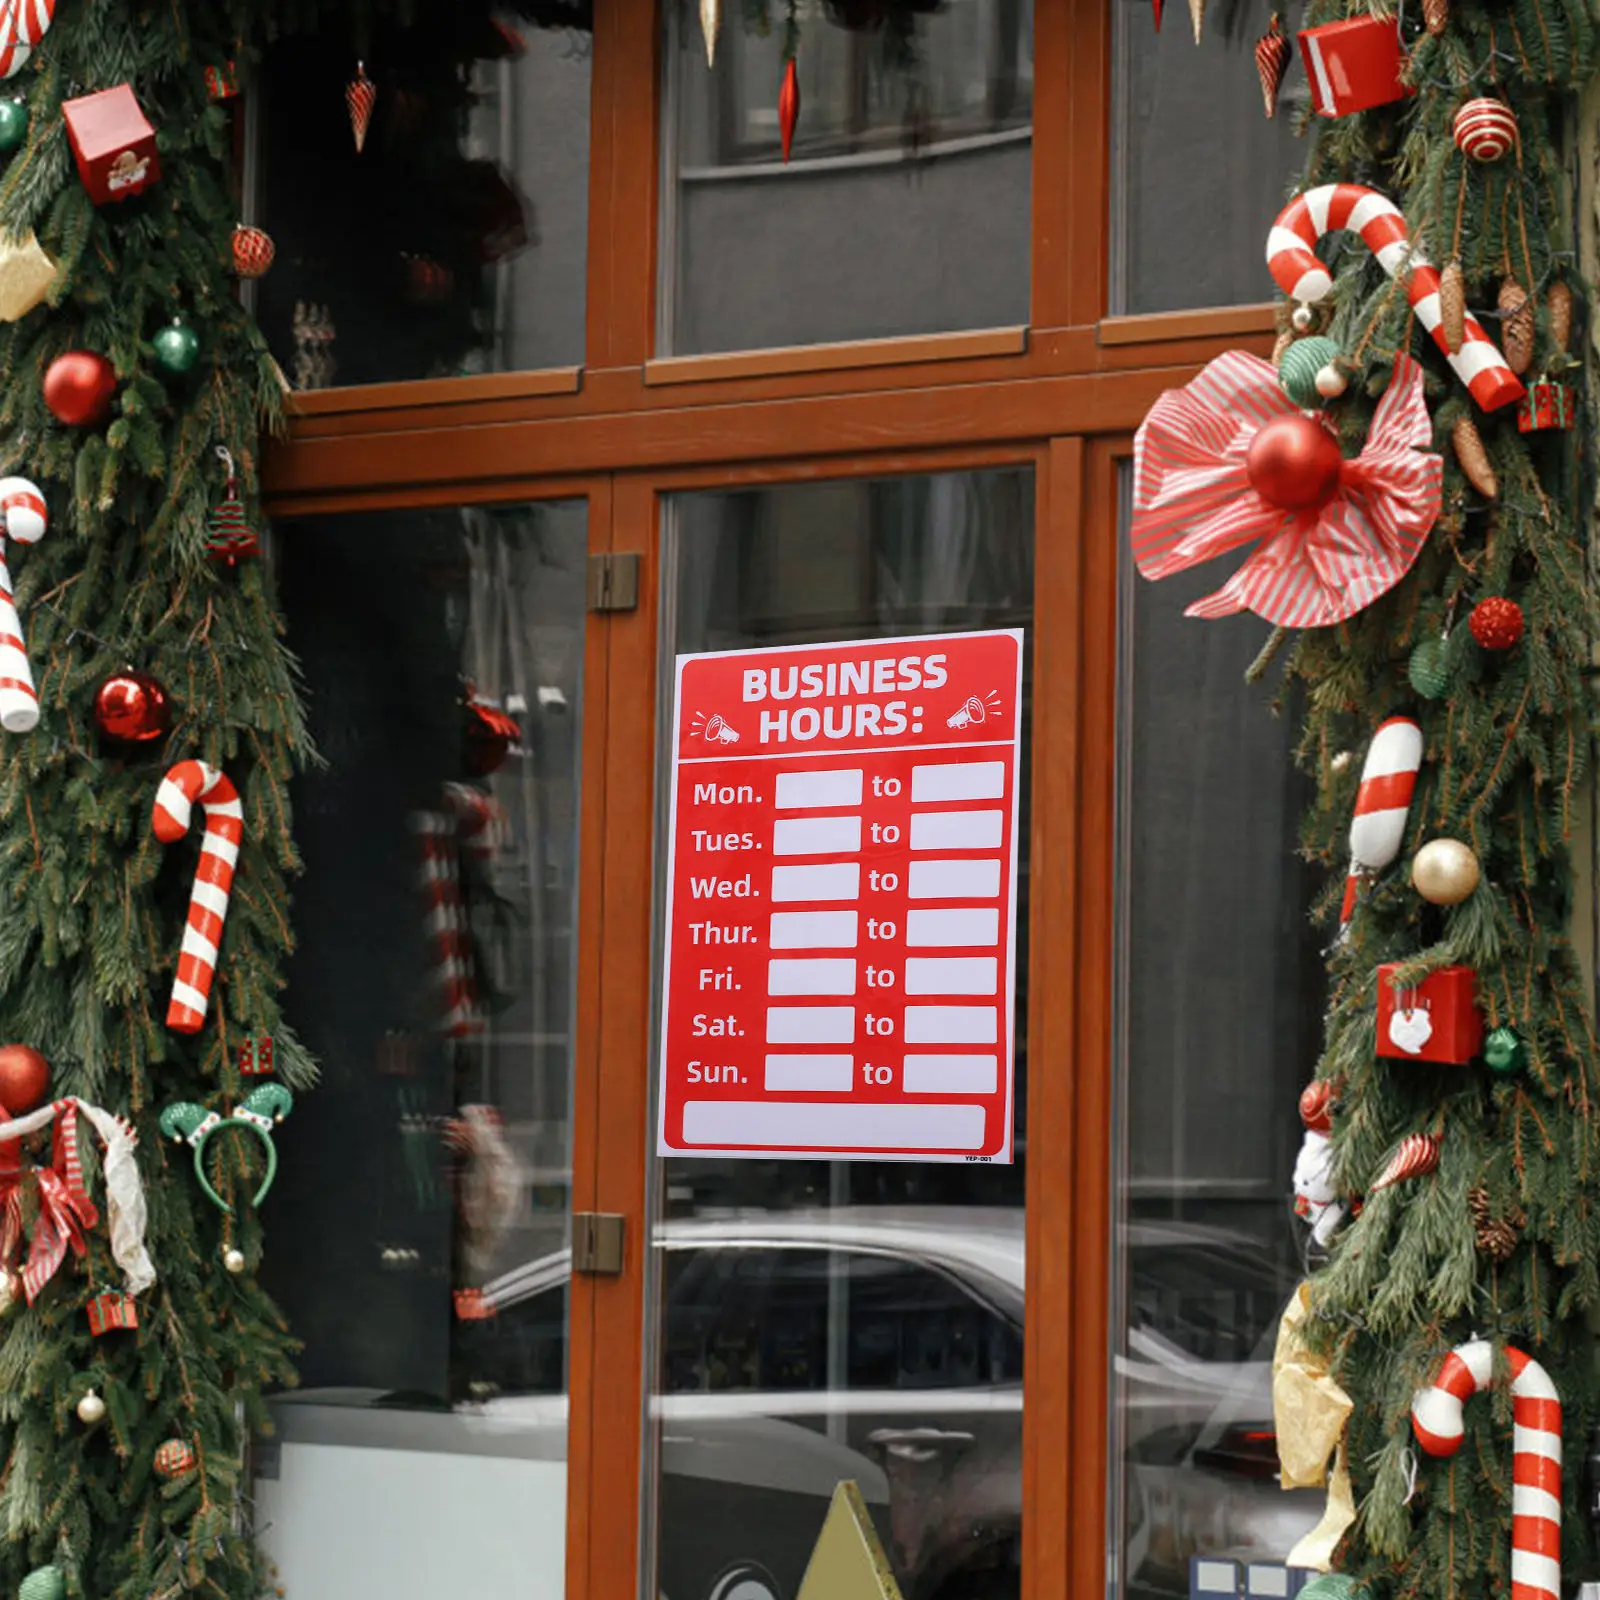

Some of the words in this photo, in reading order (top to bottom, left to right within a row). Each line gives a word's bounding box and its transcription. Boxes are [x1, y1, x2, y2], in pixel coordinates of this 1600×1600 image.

[742, 653, 949, 703] BUSINESS
[759, 701, 924, 744] HOURS:
[693, 783, 762, 806] Mon.
[871, 775, 902, 797] to
[691, 830, 762, 852] Tues.
[870, 822, 900, 844] to
[690, 873, 760, 899] Wed.
[868, 869, 899, 892] to
[688, 920, 757, 945] Thur.
[866, 917, 897, 940] to
[699, 966, 741, 991] Fri.
[865, 965, 895, 988] to
[692, 1013, 745, 1037] Sat.
[864, 1013, 894, 1036] to
[687, 1061, 748, 1084] Sun.
[862, 1062, 893, 1085] to
